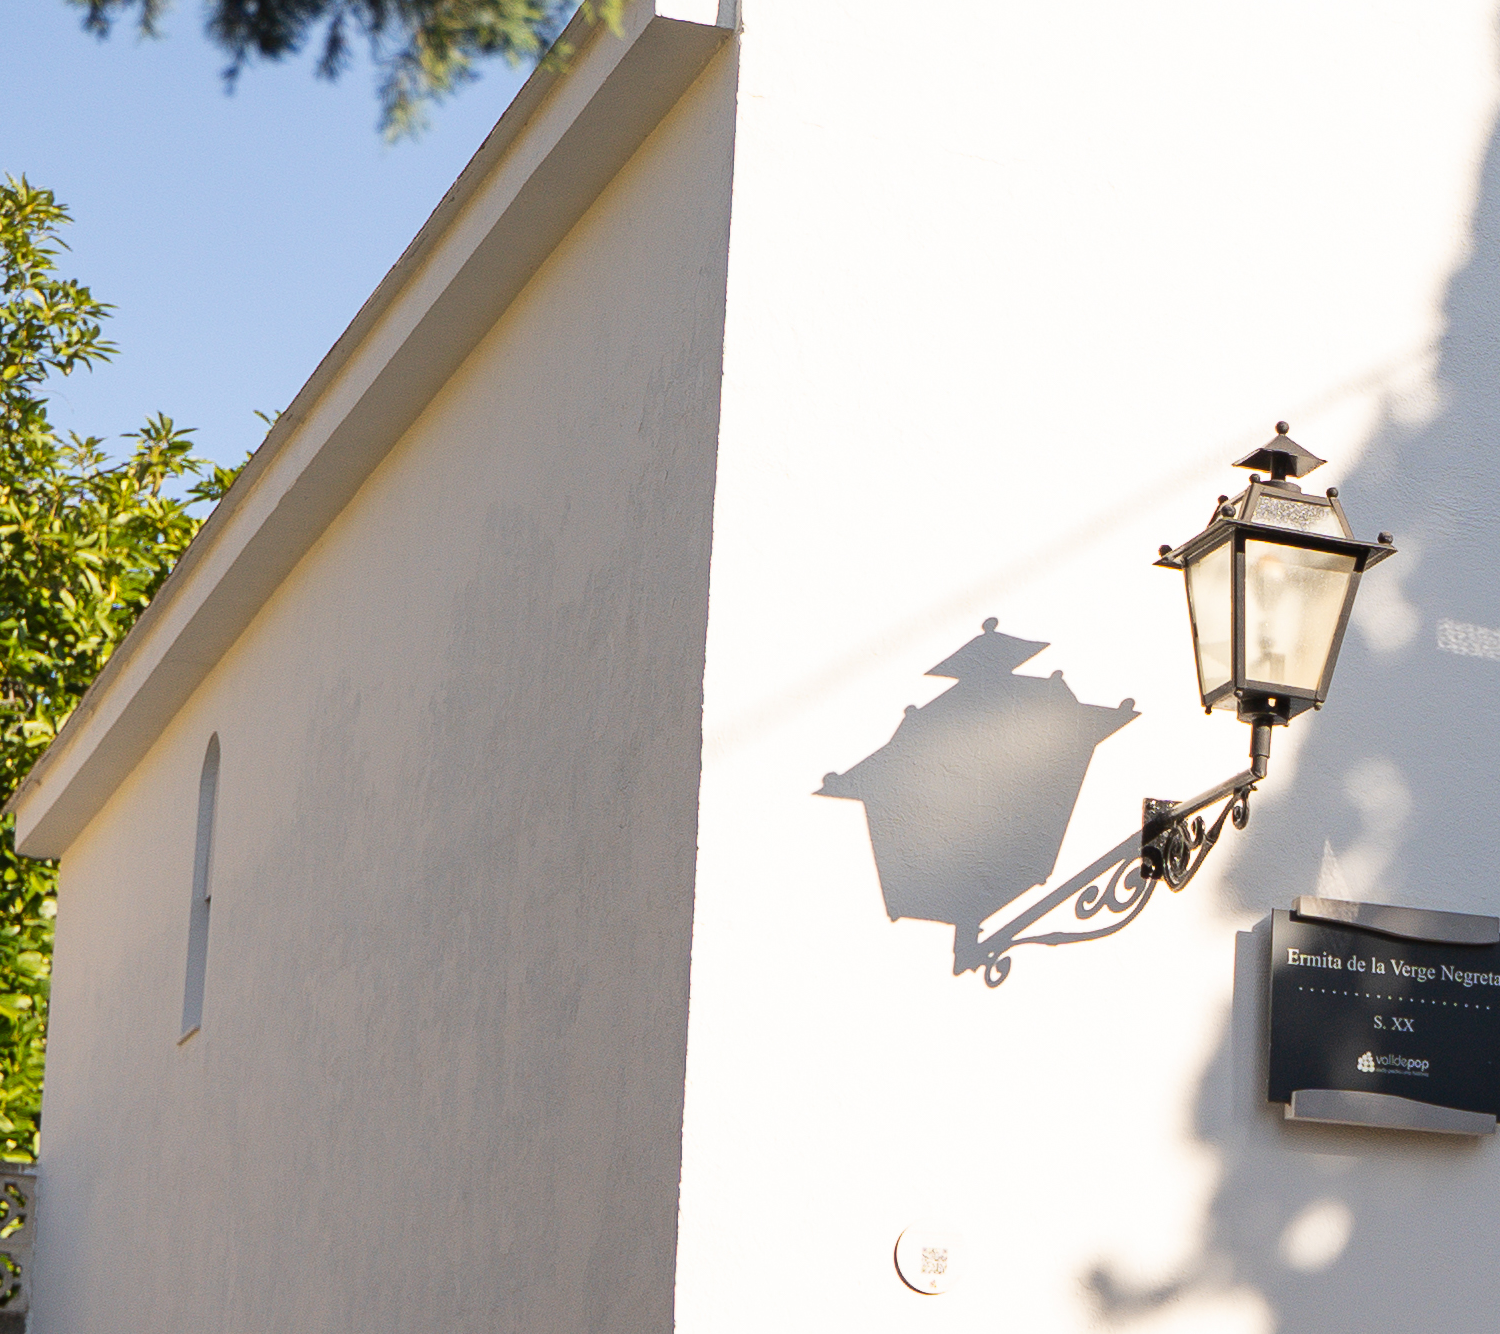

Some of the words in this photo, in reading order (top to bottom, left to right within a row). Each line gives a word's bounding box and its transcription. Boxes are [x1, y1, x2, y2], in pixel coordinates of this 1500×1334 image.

[1287, 948, 1342, 969] Ermita
[1347, 955, 1366, 972] de
[1371, 957, 1386, 975] la
[1390, 959, 1436, 982] Verge
[1373, 1015, 1387, 1030] S.
[1391, 1017, 1415, 1033] XX
